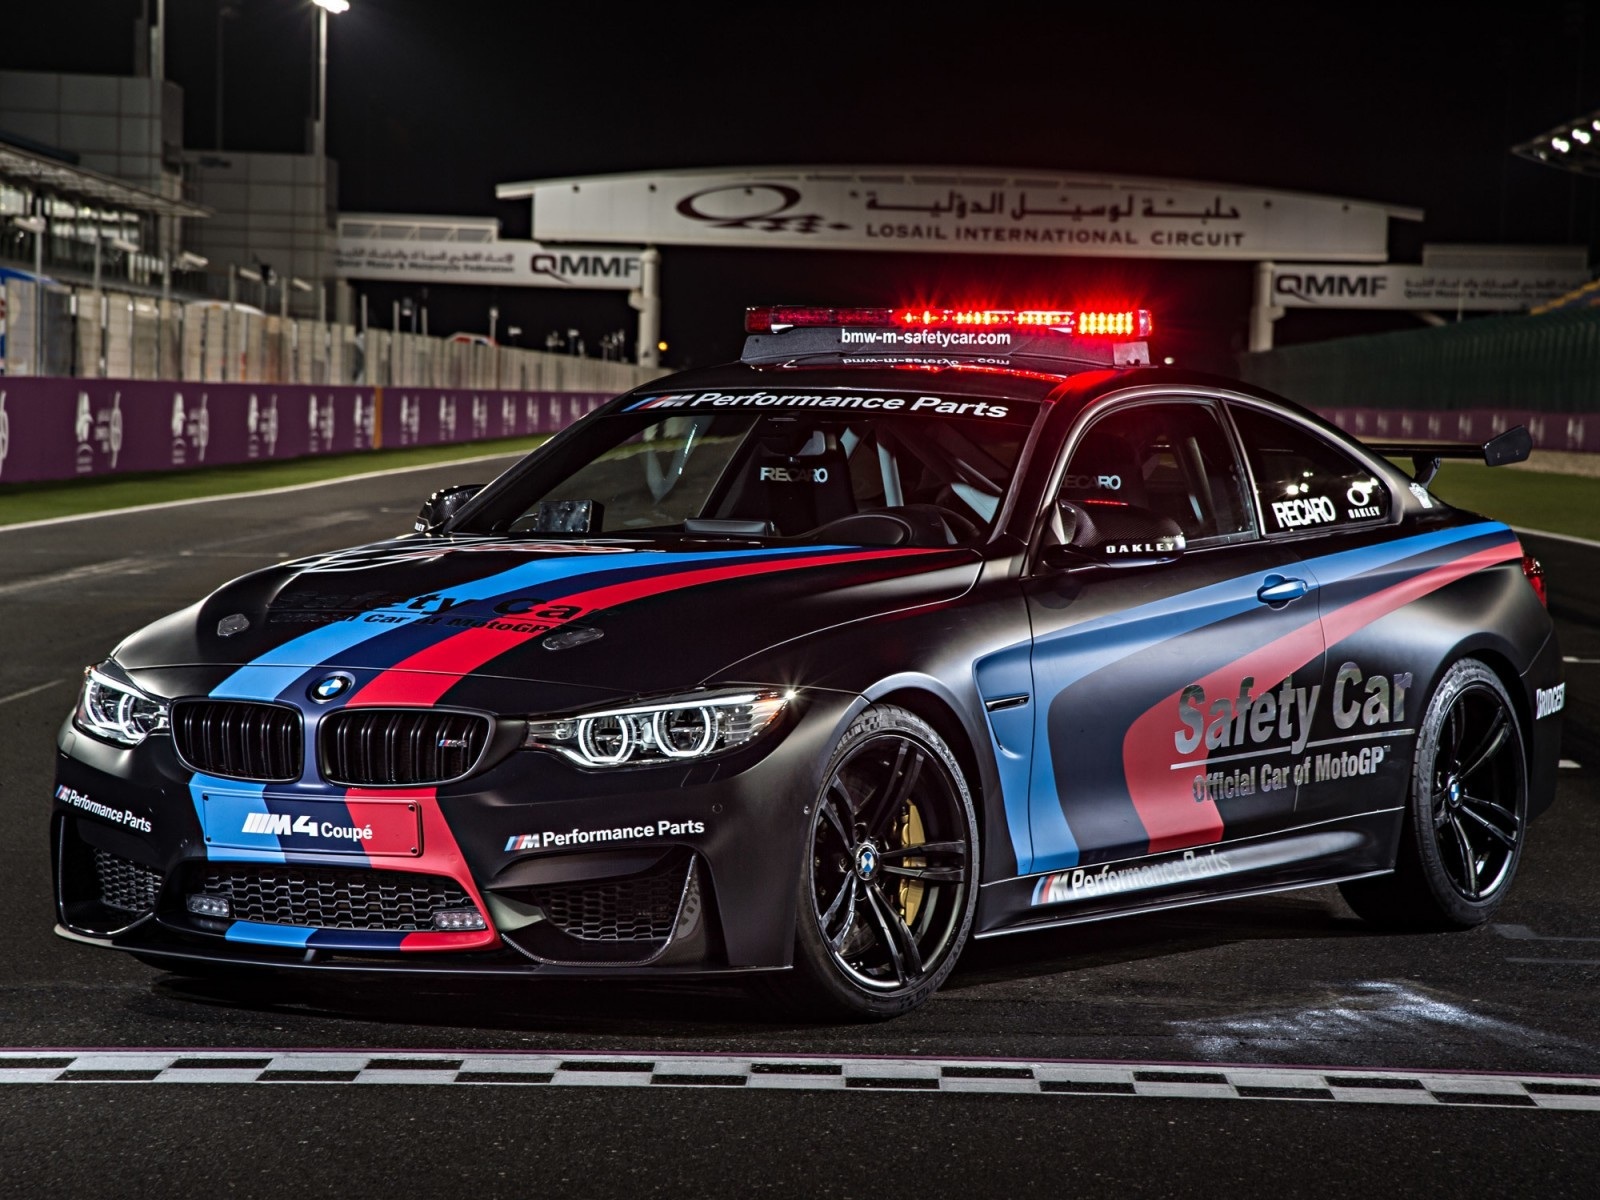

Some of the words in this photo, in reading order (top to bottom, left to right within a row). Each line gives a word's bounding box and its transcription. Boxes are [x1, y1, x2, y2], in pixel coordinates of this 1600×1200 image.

[1012, 191, 1134, 222] لوسيل
[1142, 196, 1240, 225] حلبة
[866, 224, 947, 240] LOSAIL
[956, 227, 1139, 244] INTERNATIONAL
[1151, 231, 1245, 246] CIRCUIT
[530, 254, 641, 284] QMMF
[1275, 274, 1388, 303] QMMF
[841, 328, 1011, 347] bmw-m-safetycar.com
[690, 391, 906, 410] Performance
[910, 396, 1009, 418] Parts
[1272, 495, 1336, 528] RECARO
[1348, 506, 1380, 519] OAKLEY
[1106, 542, 1175, 554] OAKLEY
[1174, 672, 1321, 755] Safety
[1332, 661, 1413, 730] Car
[1192, 767, 1255, 803] Official
[1260, 764, 1290, 792] Car
[1294, 756, 1311, 786] of
[68, 790, 123, 823] Performance
[123, 810, 152, 833] Parts
[321, 821, 373, 842] Coupé
[543, 829, 655, 847] Performance
[658, 820, 705, 836] Parts
[1071, 861, 1183, 898] Performance
[1183, 849, 1232, 876] Parts
